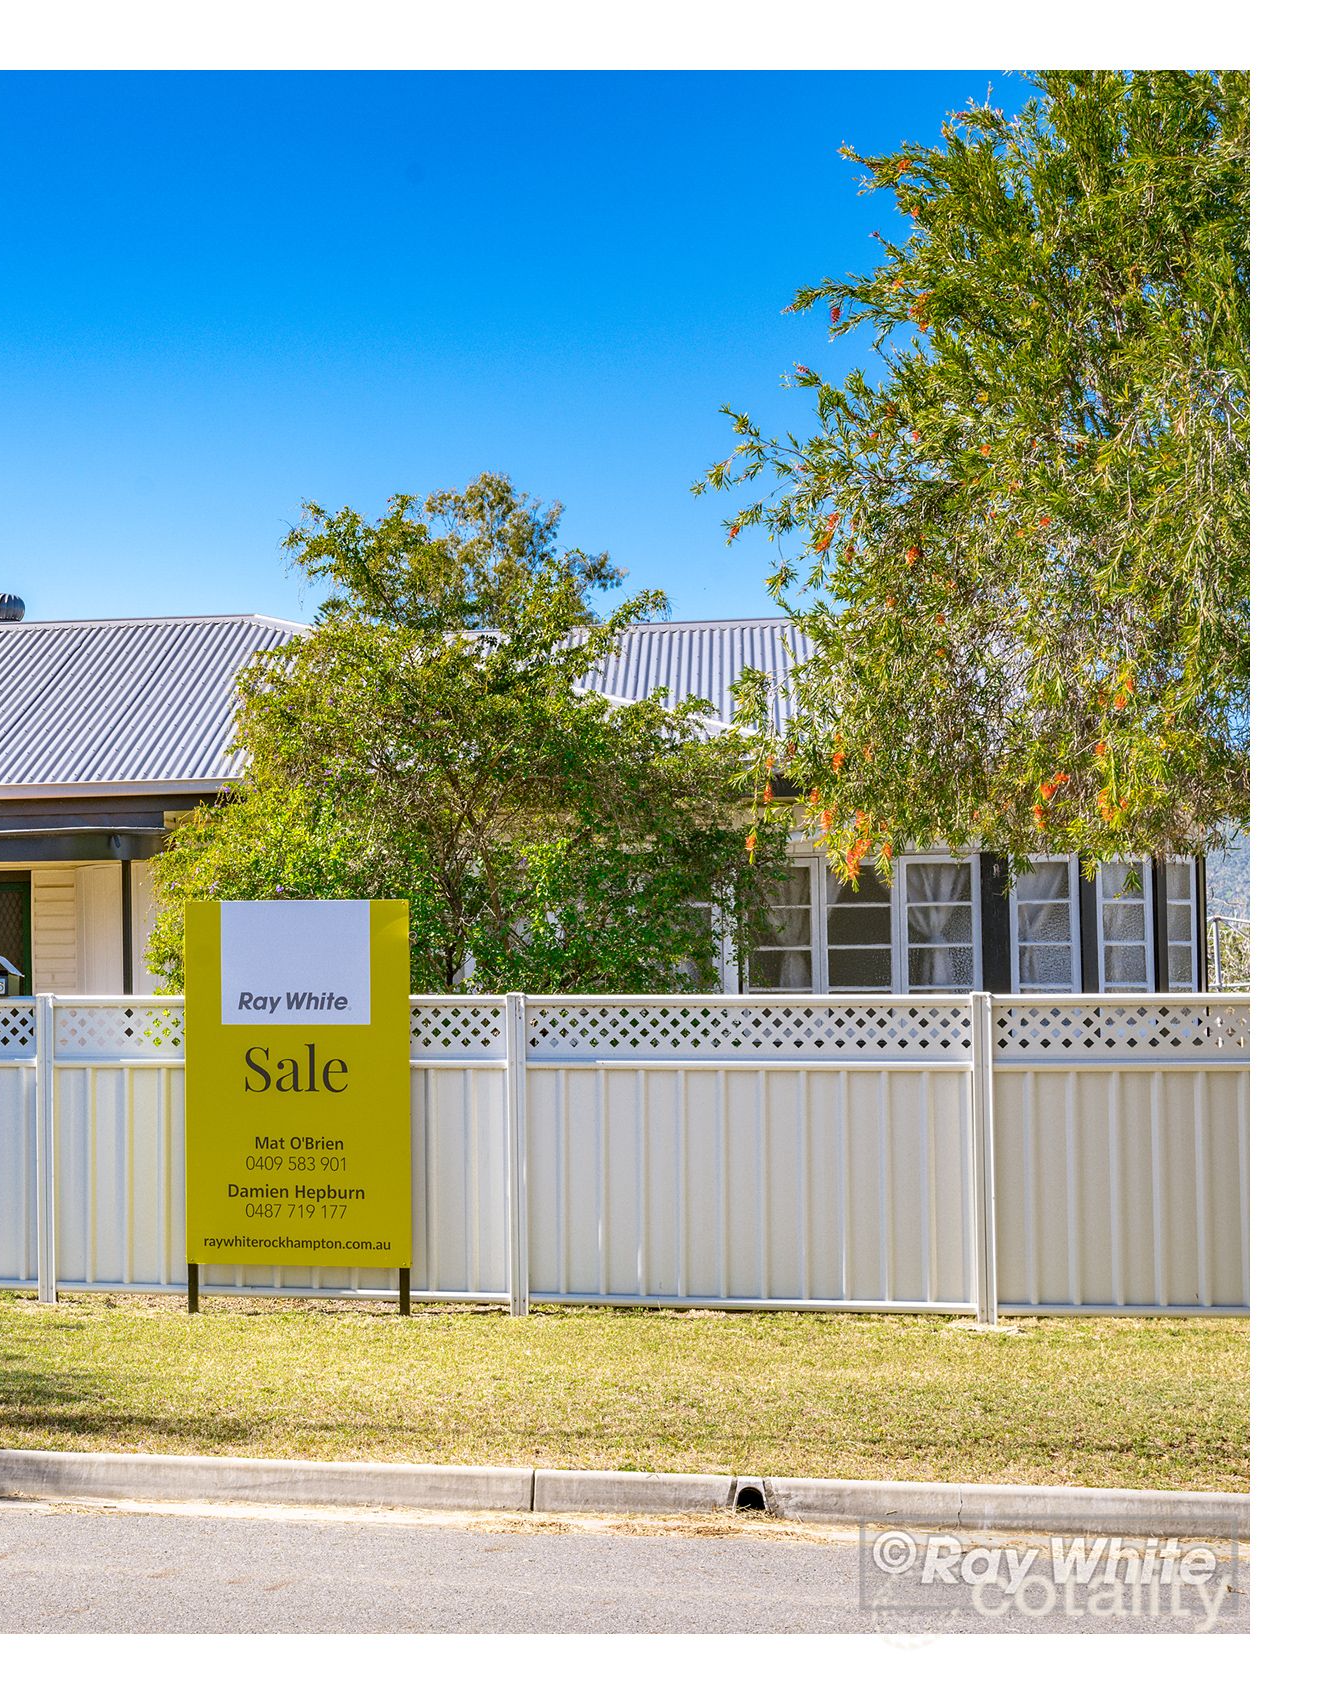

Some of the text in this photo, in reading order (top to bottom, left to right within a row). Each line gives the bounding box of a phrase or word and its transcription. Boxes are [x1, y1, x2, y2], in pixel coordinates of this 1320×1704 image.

[238, 991, 349, 1013] Ray White
[244, 1043, 349, 1093] Sale
[255, 1136, 344, 1151] Mat O'Brien
[245, 1156, 347, 1172] 0409 583 901
[227, 1184, 365, 1202] Damien Hepburn
[245, 1204, 348, 1219] 0487 719 177
[203, 1236, 391, 1251] raywhiterockhampton.com.au
